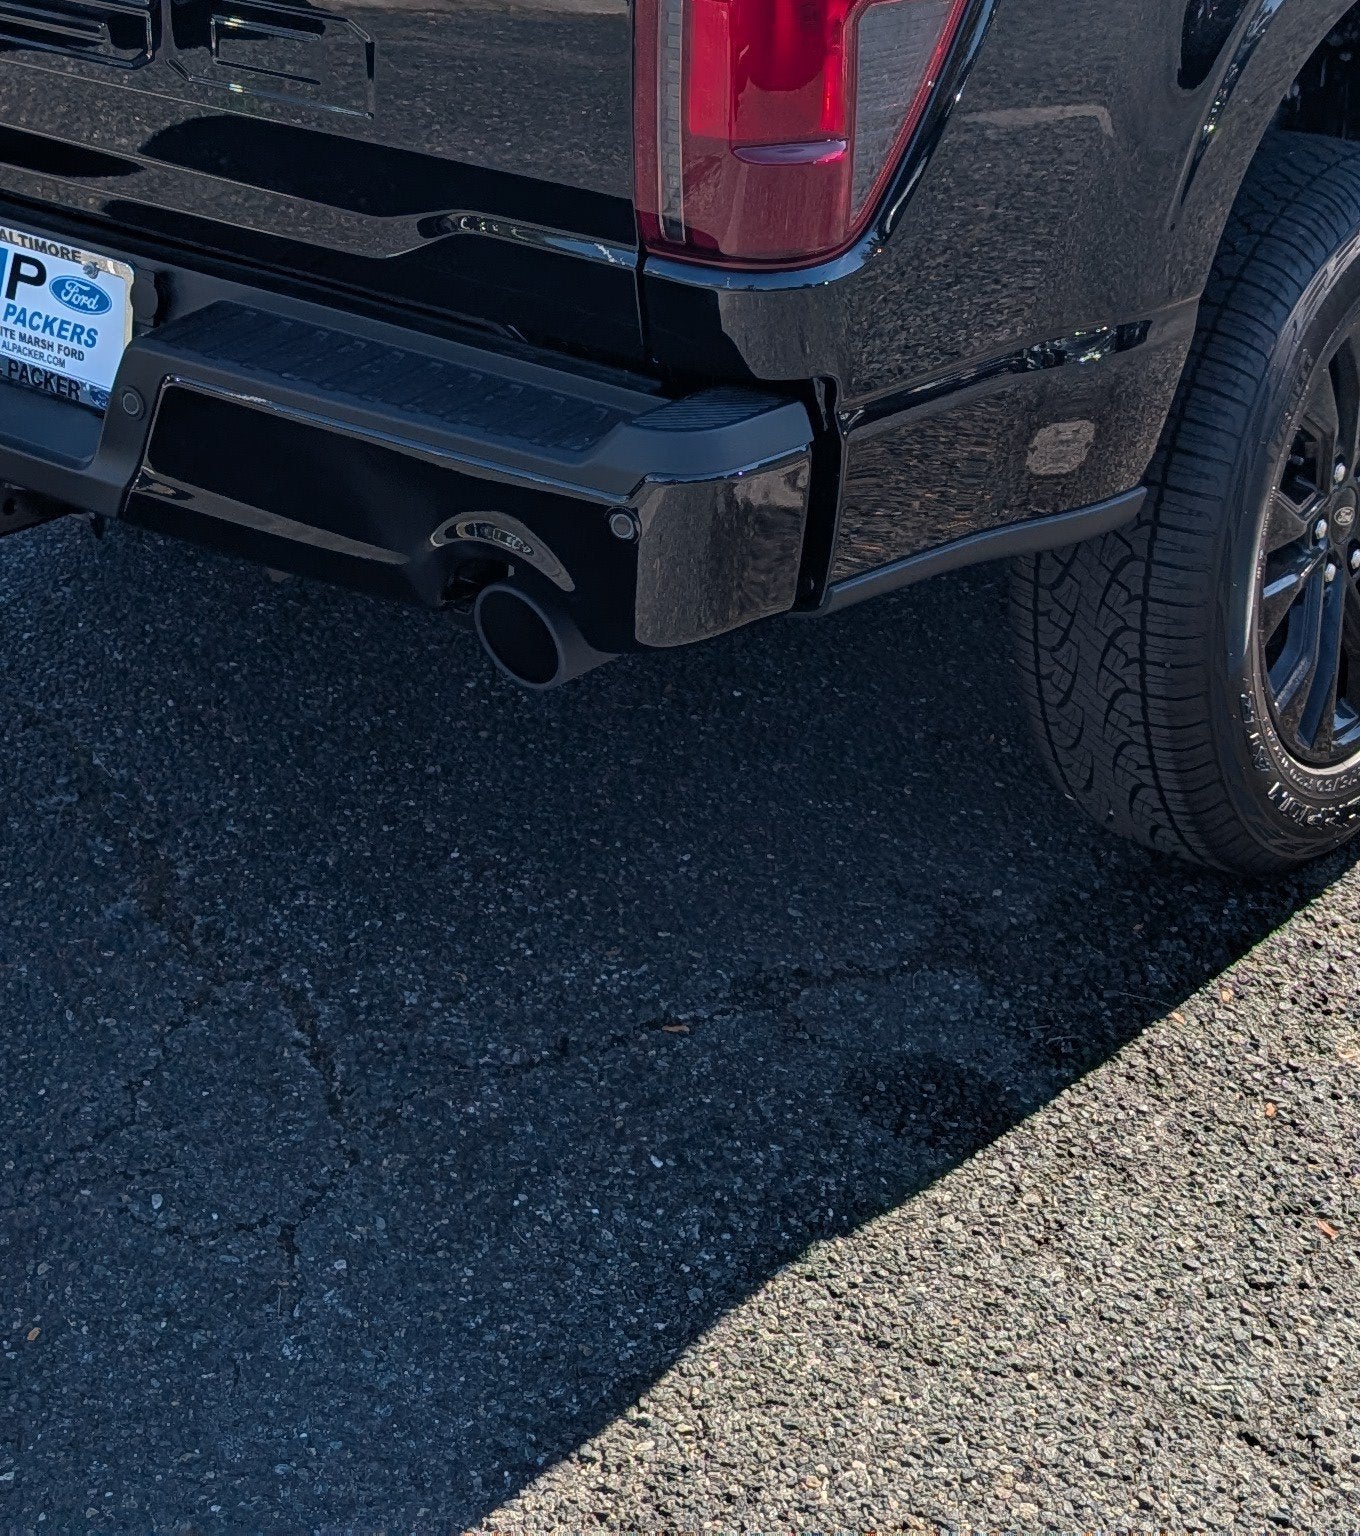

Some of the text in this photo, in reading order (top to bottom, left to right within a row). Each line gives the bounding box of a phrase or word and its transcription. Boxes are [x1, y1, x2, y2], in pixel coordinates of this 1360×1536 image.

[60, 279, 99, 311] Ford
[2, 302, 99, 349] PACKERS
[1, 339, 67, 369] ALPACKER.COM
[18, 332, 56, 355] MARSH
[56, 344, 86, 362] FORD
[7, 358, 82, 402] PACKER
